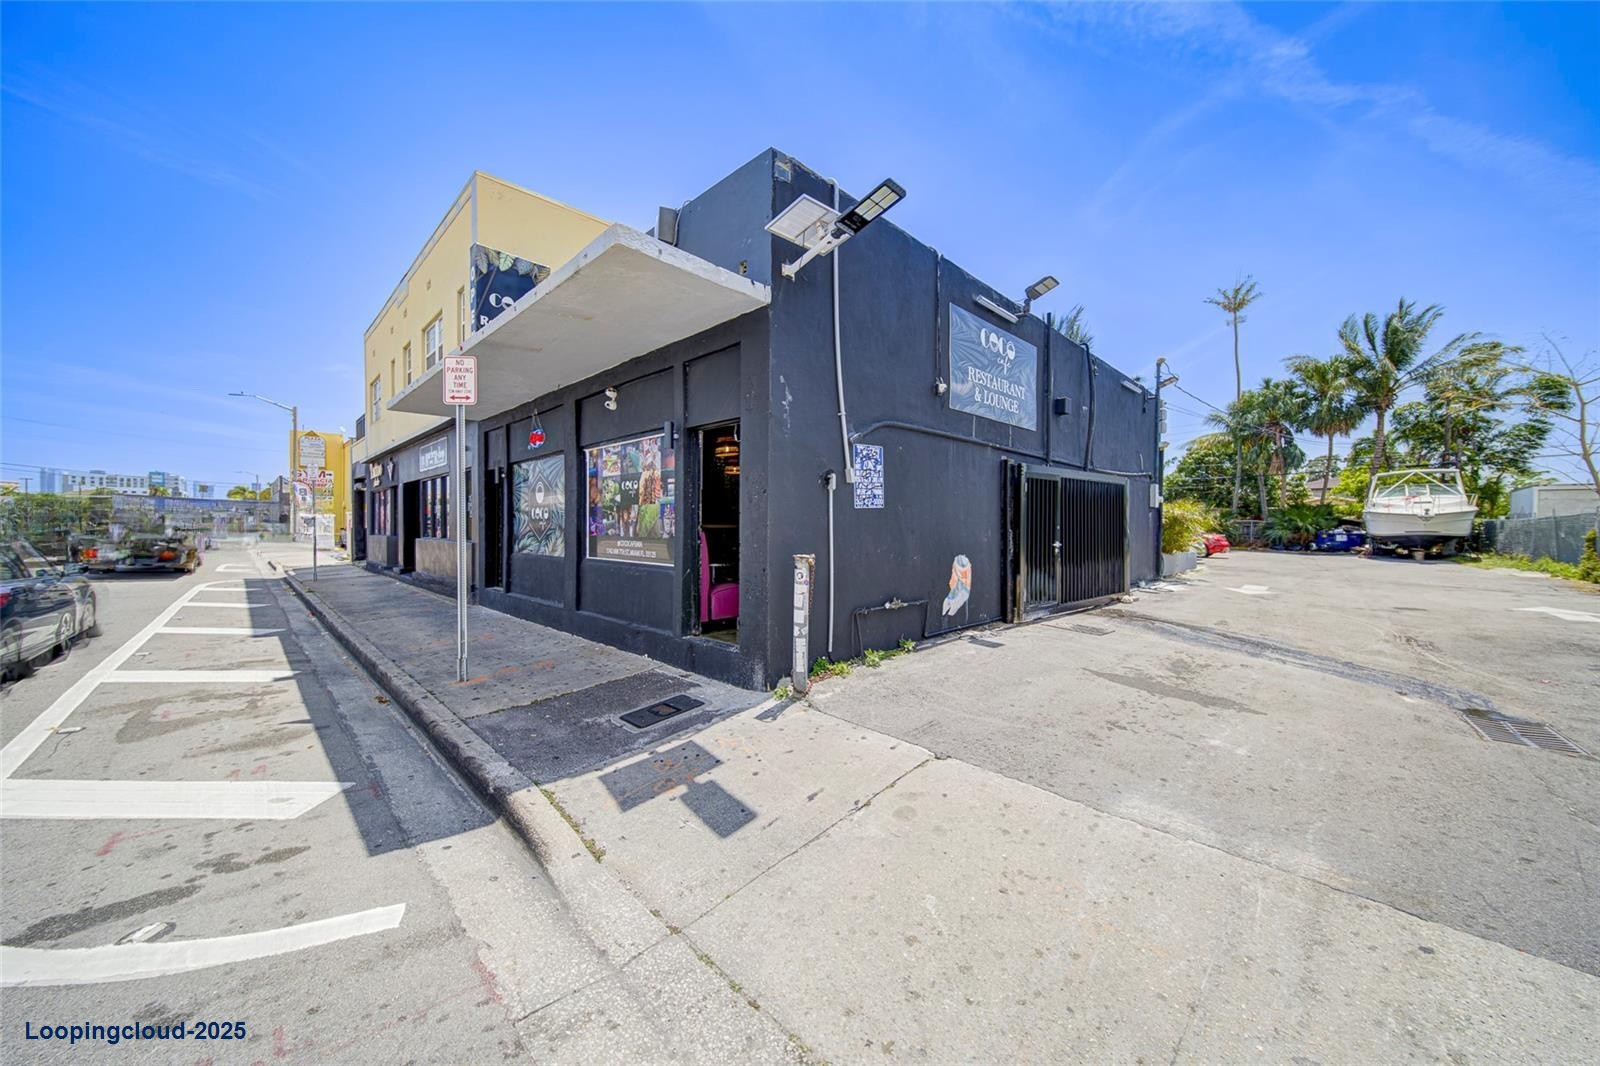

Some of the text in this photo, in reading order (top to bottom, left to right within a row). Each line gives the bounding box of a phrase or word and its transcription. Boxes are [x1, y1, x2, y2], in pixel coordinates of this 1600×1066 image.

[980, 328, 1016, 360] COCO
[967, 366, 1025, 400] RESTAURANT
[974, 387, 1019, 413] & LOUNGE
